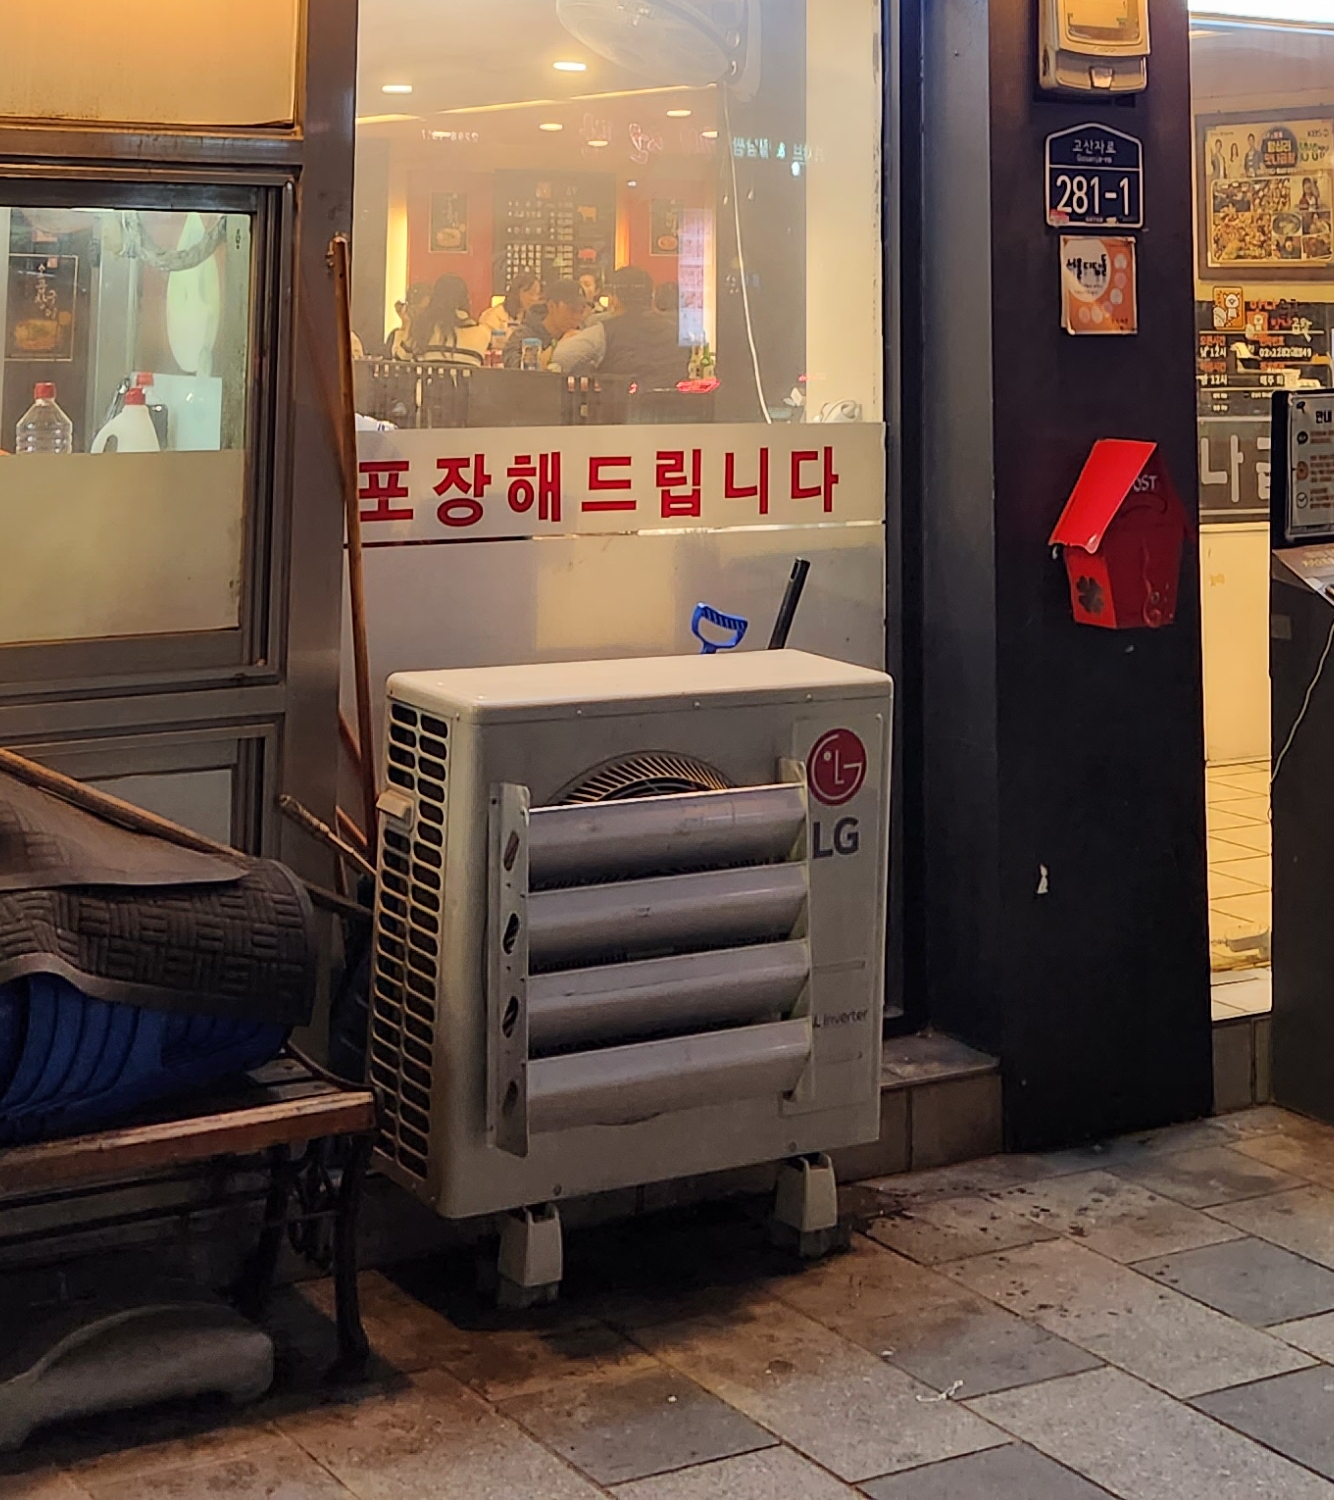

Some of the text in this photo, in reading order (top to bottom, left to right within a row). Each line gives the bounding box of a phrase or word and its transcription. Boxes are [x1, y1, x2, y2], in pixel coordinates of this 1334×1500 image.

[1073, 139, 1116, 154] 고산자로
[1056, 174, 1129, 216] 281-1
[358, 445, 839, 528] 포장해드립니다
[1132, 474, 1157, 492] OST
[813, 817, 860, 859] LG
